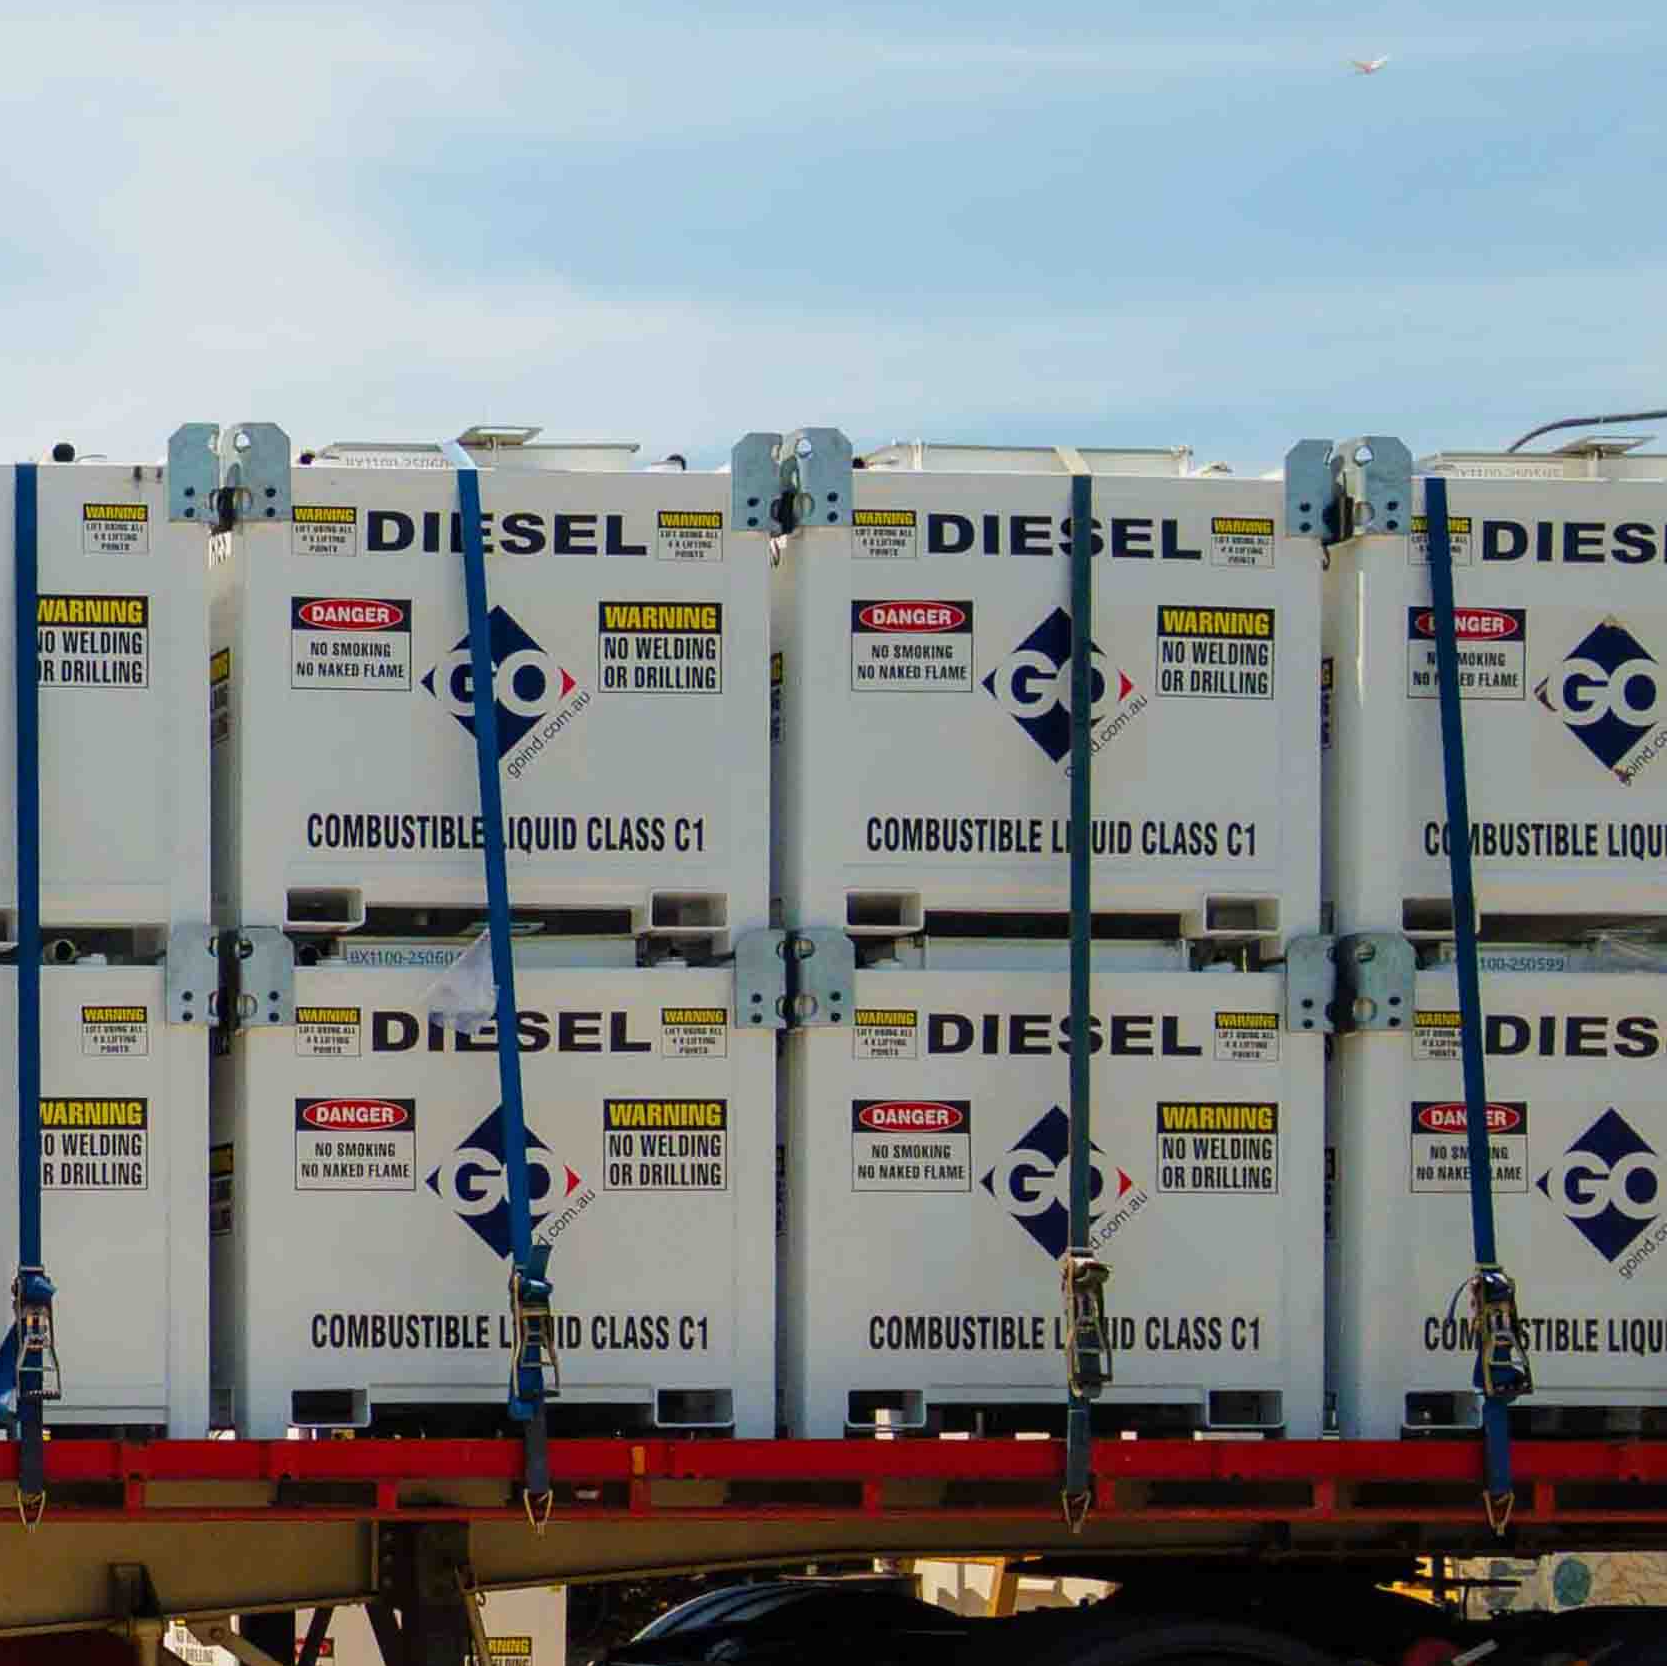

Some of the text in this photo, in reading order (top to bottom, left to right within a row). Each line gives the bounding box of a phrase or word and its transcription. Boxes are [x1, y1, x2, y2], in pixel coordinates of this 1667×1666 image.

[86, 506, 146, 520] WARNING
[294, 509, 355, 523] WARNING
[312, 606, 390, 624] DANGER
[605, 607, 716, 629] WARNING
[872, 609, 952, 626] DANGER
[1163, 611, 1269, 635] WARNING
[63, 631, 142, 654] WELDING
[605, 636, 716, 659] NO WELDING
[872, 645, 952, 659] NO SMOKING
[1163, 640, 1268, 666] NO WELDING
[62, 660, 142, 683] DRILLING
[605, 666, 715, 688] OR DRILLING
[858, 665, 966, 680] NO NAKED FLAME
[1162, 669, 1268, 694] OR DRILLING
[1550, 658, 1667, 726] GO
[506, 691, 592, 779] goind.com.au
[504, 816, 577, 858] IQUID
[588, 817, 664, 851] CLASS
[675, 818, 703, 851] C1
[867, 817, 1254, 856] COMBUSTIBLE LIUID CLASS C1
[84, 1008, 144, 1021] WARNING
[316, 1107, 395, 1124] DANGER
[610, 1104, 721, 1125] WARNING
[872, 1109, 950, 1126] DANGER
[1163, 1107, 1272, 1130] WARNING
[62, 1133, 141, 1156] WELDING
[315, 1143, 395, 1157] NO SMOKING
[610, 1134, 721, 1157] NO WELDING
[1163, 1137, 1272, 1160] NO WELDING
[61, 1163, 142, 1185] DRILLING
[302, 1163, 409, 1177] NO NAKED FLAME
[610, 1163, 721, 1185] OR DRILLING
[1163, 1166, 1271, 1189] OR DRILLING
[1550, 1151, 1667, 1219] GO
[312, 1314, 707, 1350] COMBUSTIBLE CLASS C1
[870, 1316, 1259, 1350] COMBUSTIBLE CLASS C1
